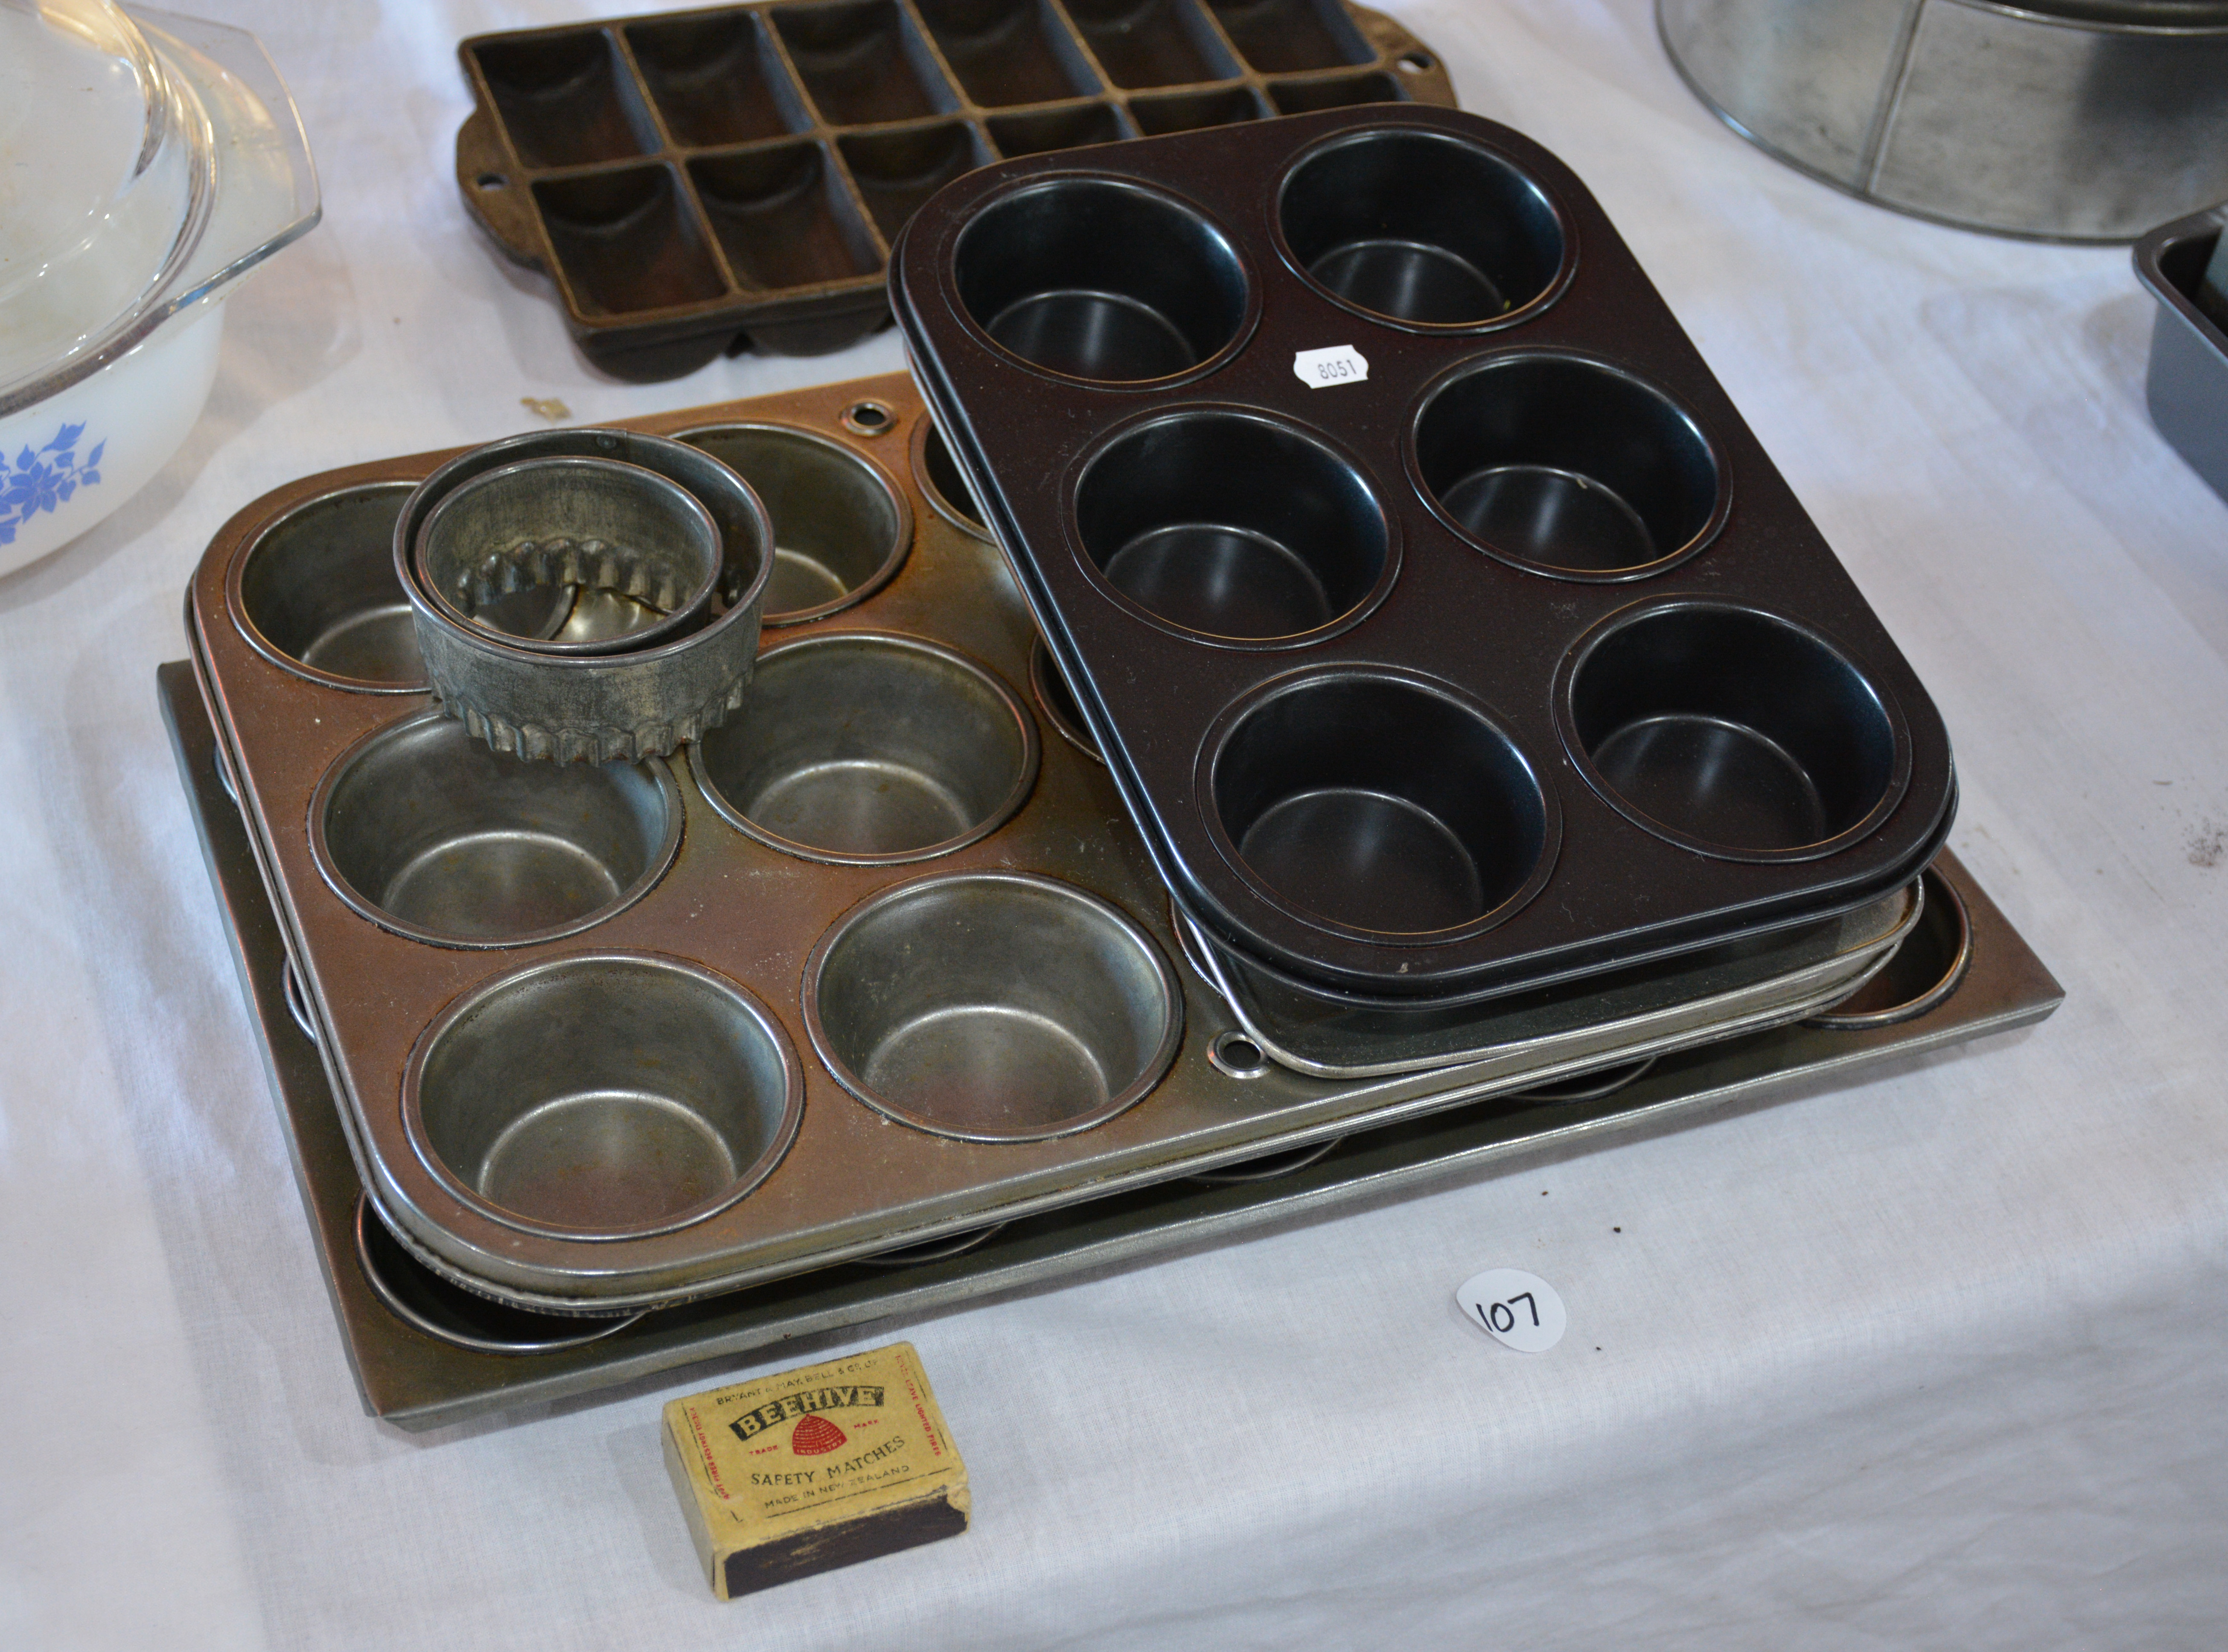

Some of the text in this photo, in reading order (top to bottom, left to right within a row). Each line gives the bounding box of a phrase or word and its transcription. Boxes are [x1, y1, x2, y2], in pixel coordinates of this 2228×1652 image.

[1318, 359, 1357, 379] 8051
[1475, 1292, 1540, 1333] 107
[716, 1388, 761, 1405] BRYANT
[805, 1371, 833, 1382] BELL
[735, 1387, 879, 1439] BEEHIVE
[905, 1379, 919, 1401] LEAVE
[915, 1404, 931, 1432] LIGHTED
[927, 1434, 941, 1457] FIRES
[699, 1433, 713, 1460] DESTROY
[749, 1419, 880, 1456] TRADE MARK
[796, 1439, 842, 1454] INDUSTRY
[751, 1435, 905, 1486] SAFETY MATCHES
[764, 1465, 910, 1509] MADE IN NEW ZEALAND
